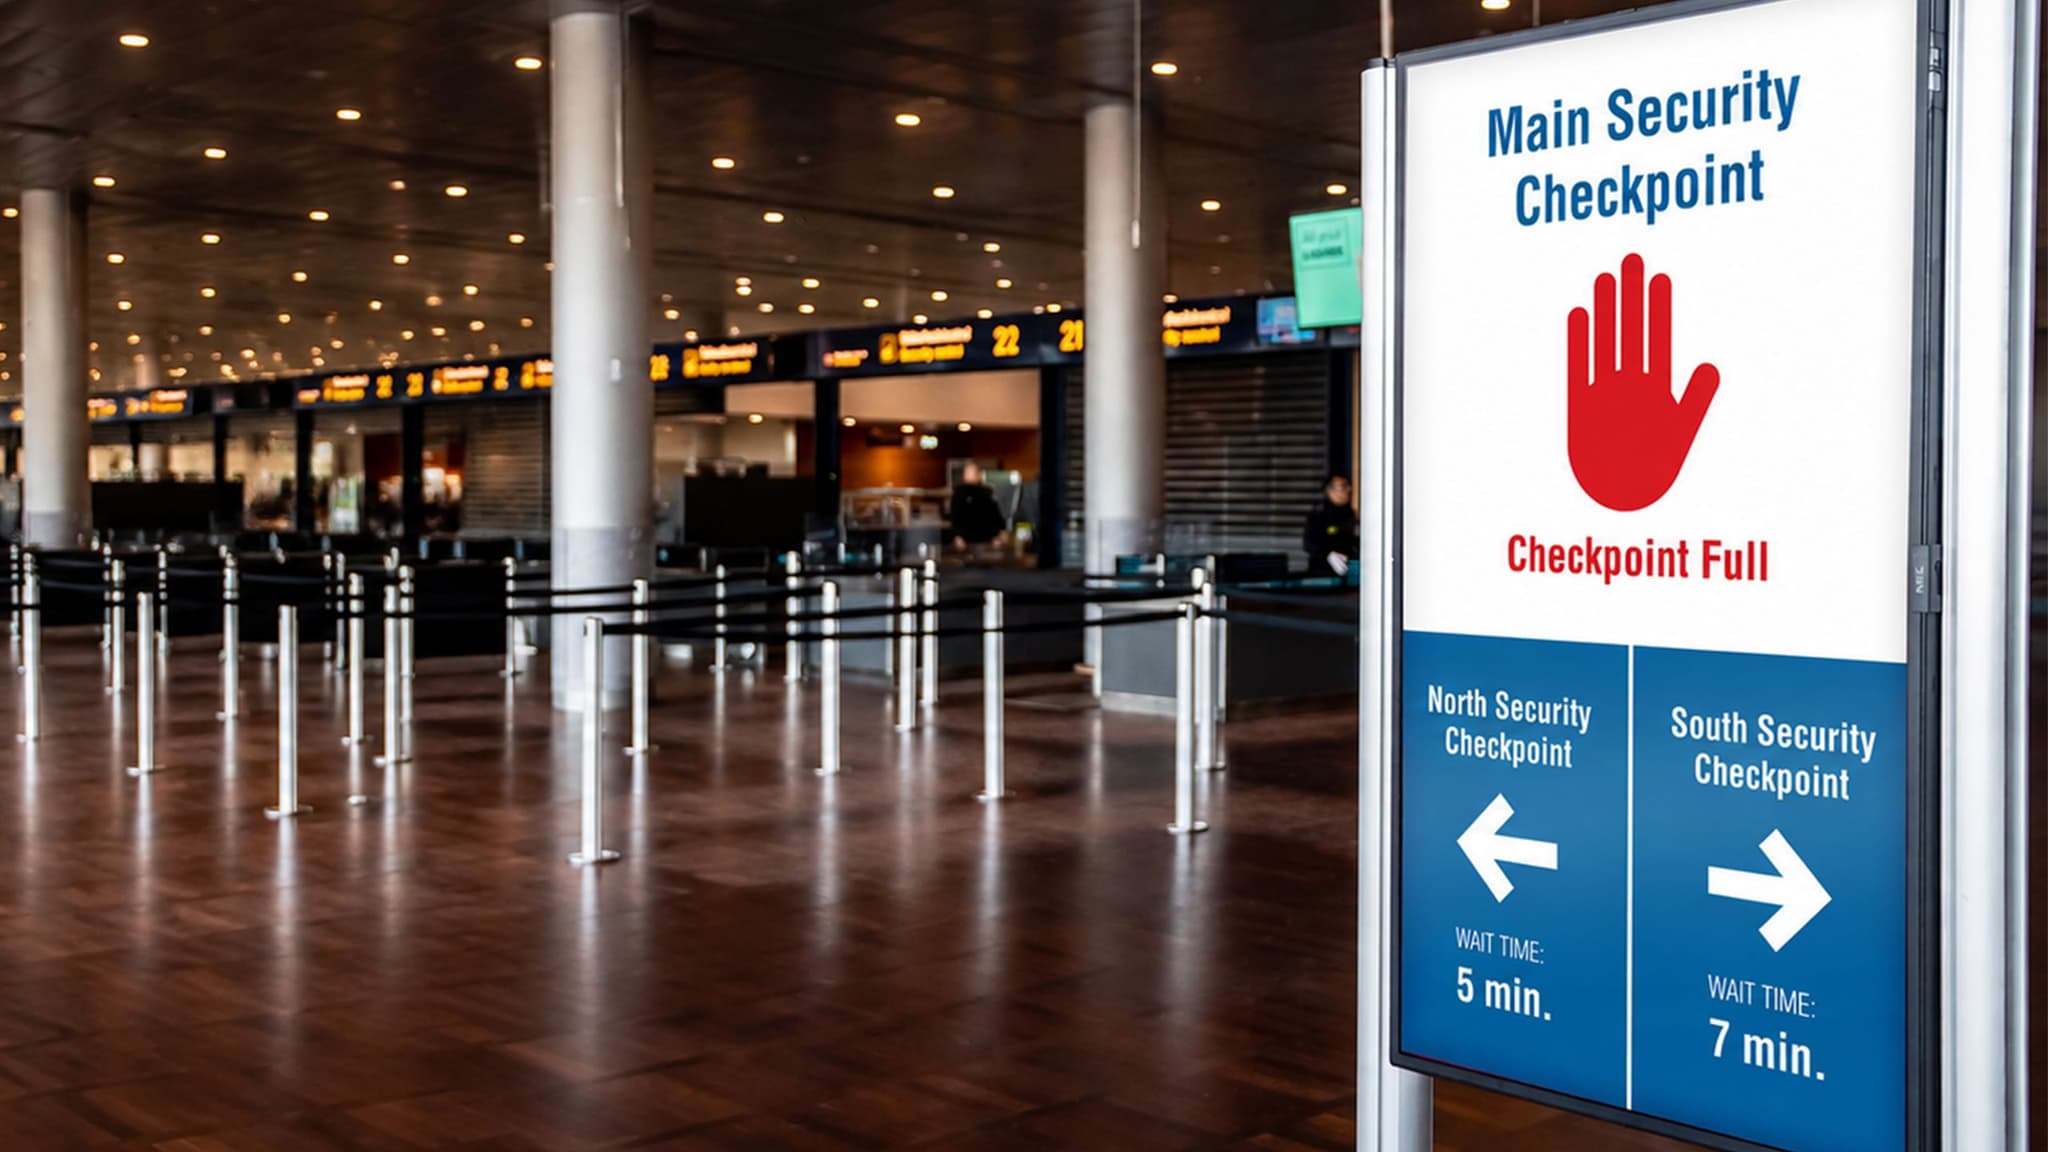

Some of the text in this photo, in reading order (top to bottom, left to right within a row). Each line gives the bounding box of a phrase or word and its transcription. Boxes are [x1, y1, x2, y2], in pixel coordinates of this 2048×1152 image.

[1488, 69, 1801, 158] Main Security
[1515, 149, 1765, 227] Checkpoint
[992, 323, 1020, 358] 22
[1507, 534, 1768, 586] Checkpoint Full
[1428, 684, 1592, 735] North Security
[1671, 706, 1876, 764] South Security
[1445, 726, 1572, 769] Checkpoint
[1695, 752, 1849, 801] Checkpoint
[1455, 927, 1544, 964] WAIT TIME:
[1457, 966, 1551, 1021] 5 min.
[1708, 974, 1816, 1019] WAIT TIME:
[1709, 1017, 1825, 1081] 7 min.
